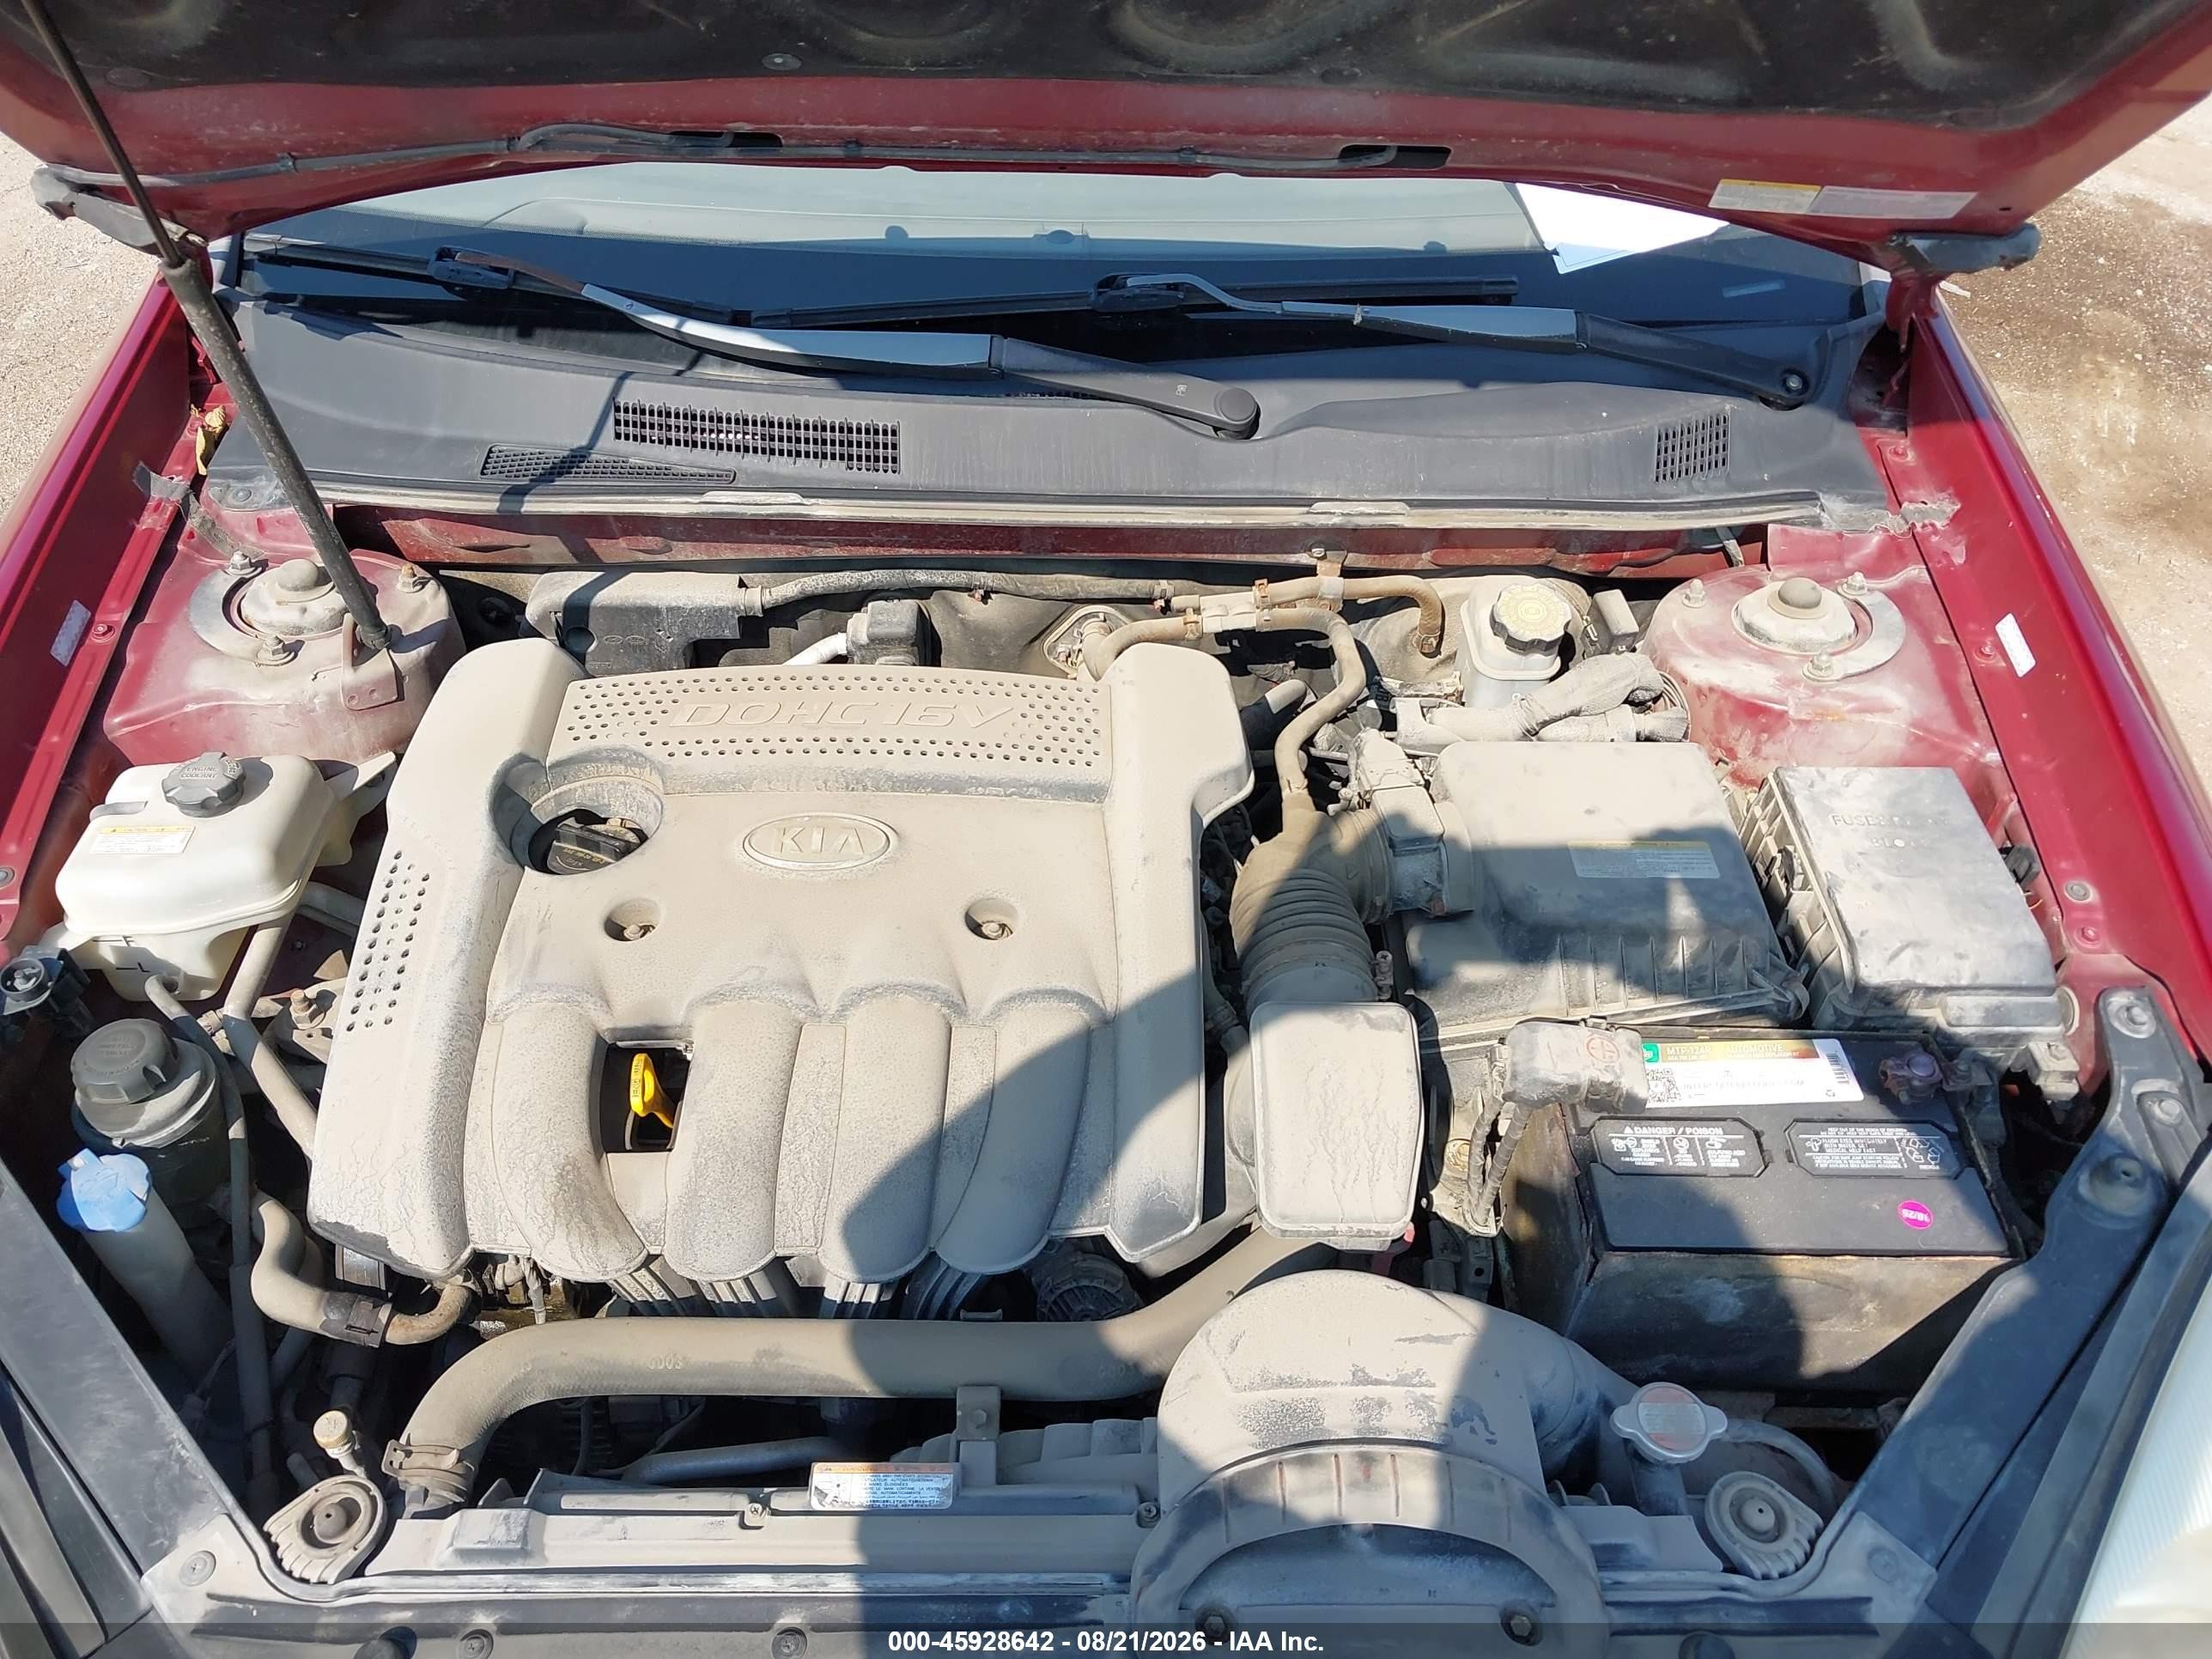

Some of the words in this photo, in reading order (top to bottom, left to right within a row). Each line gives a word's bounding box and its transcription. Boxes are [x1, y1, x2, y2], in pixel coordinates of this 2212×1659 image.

[668, 701, 880, 728] DOHC
[882, 702, 1014, 729] 16V
[771, 826, 866, 854] KIA
[137, 962, 151, 973] L
[1685, 1127, 1724, 1135] POISON
